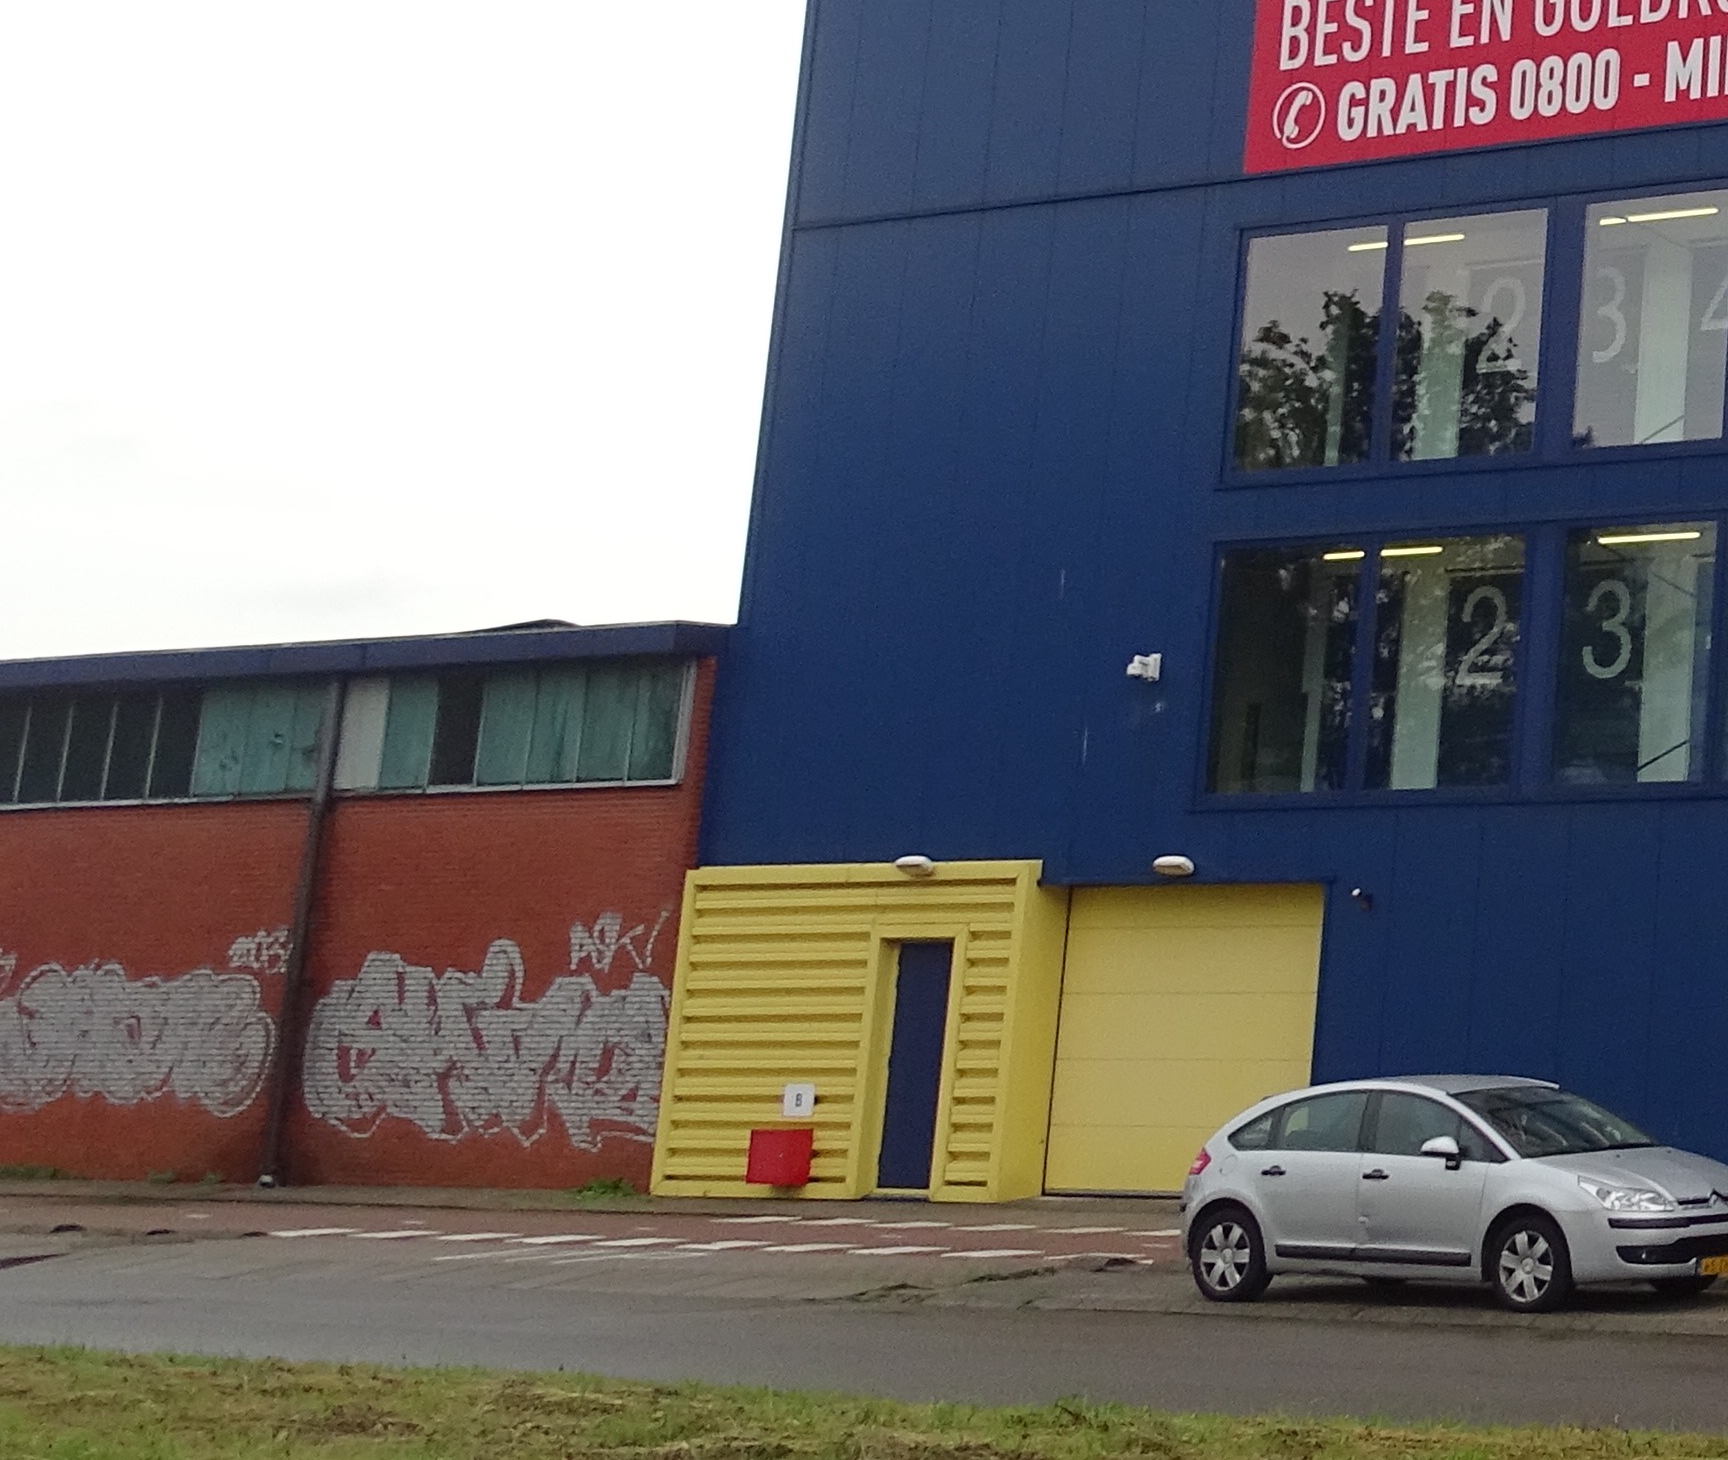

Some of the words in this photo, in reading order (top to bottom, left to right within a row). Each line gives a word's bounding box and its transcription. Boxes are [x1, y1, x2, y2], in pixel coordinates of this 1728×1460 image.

[1336, 64, 1497, 142] GRATIS
[1509, 47, 1621, 121] 0800
[1592, 265, 1626, 364] 3
[1457, 584, 1507, 686] 2
[1581, 579, 1632, 679] 3
